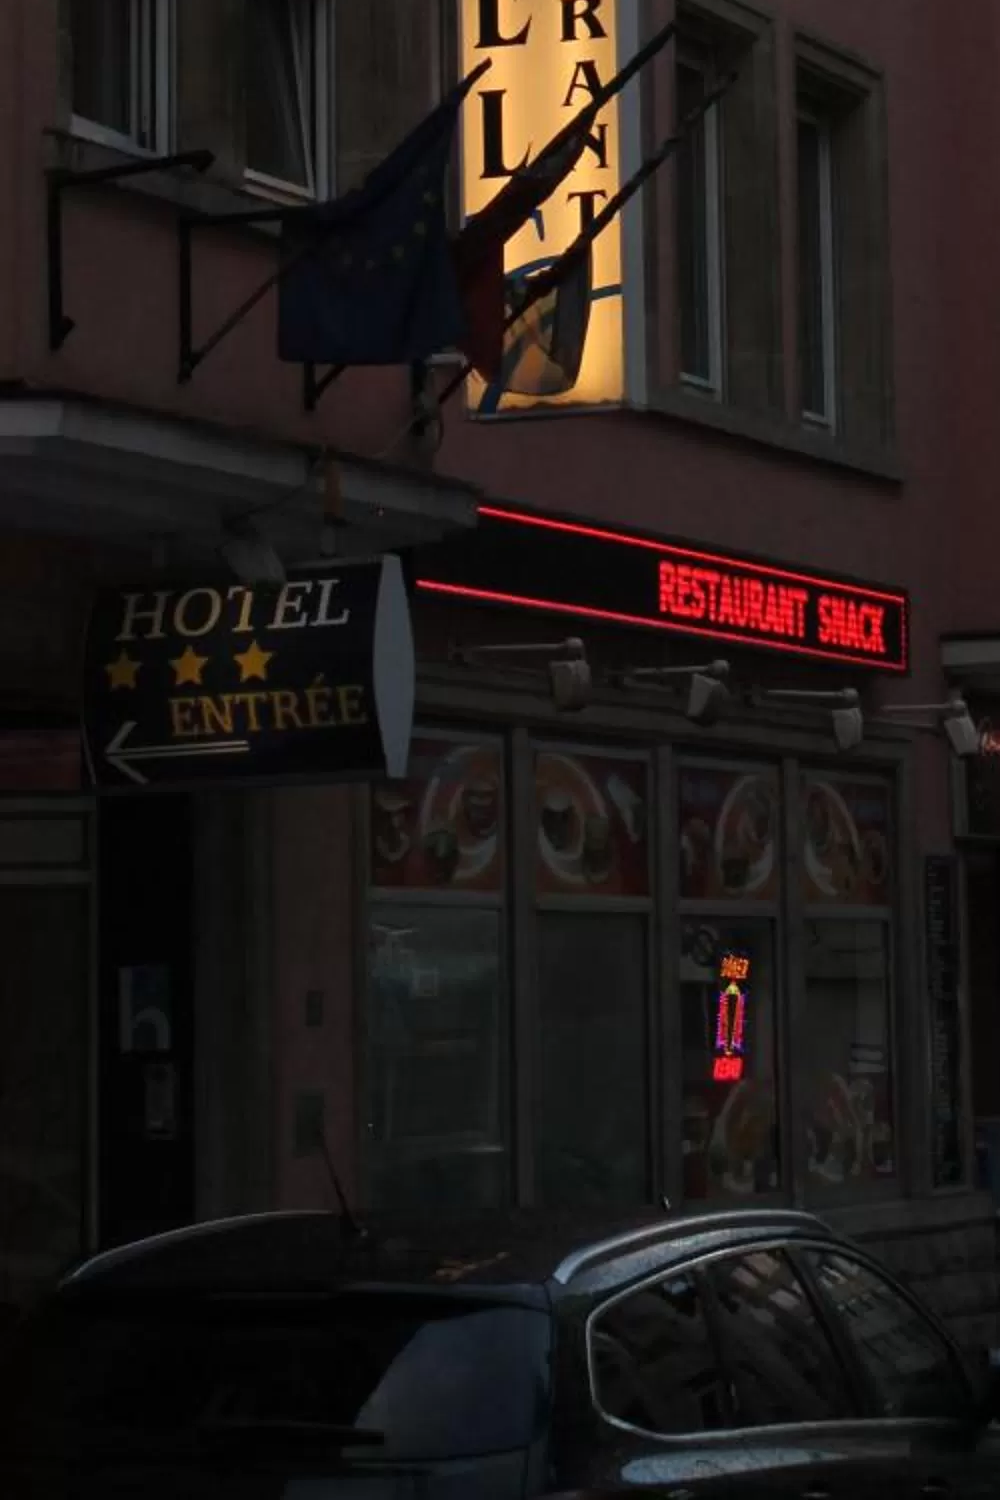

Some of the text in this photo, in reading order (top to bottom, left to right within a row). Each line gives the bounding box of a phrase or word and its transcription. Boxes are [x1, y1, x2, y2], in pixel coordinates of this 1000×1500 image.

[114, 578, 351, 642] HOTEL
[658, 560, 887, 654] RESTAURANT SNACK
[168, 672, 371, 738] ENTRÉE
